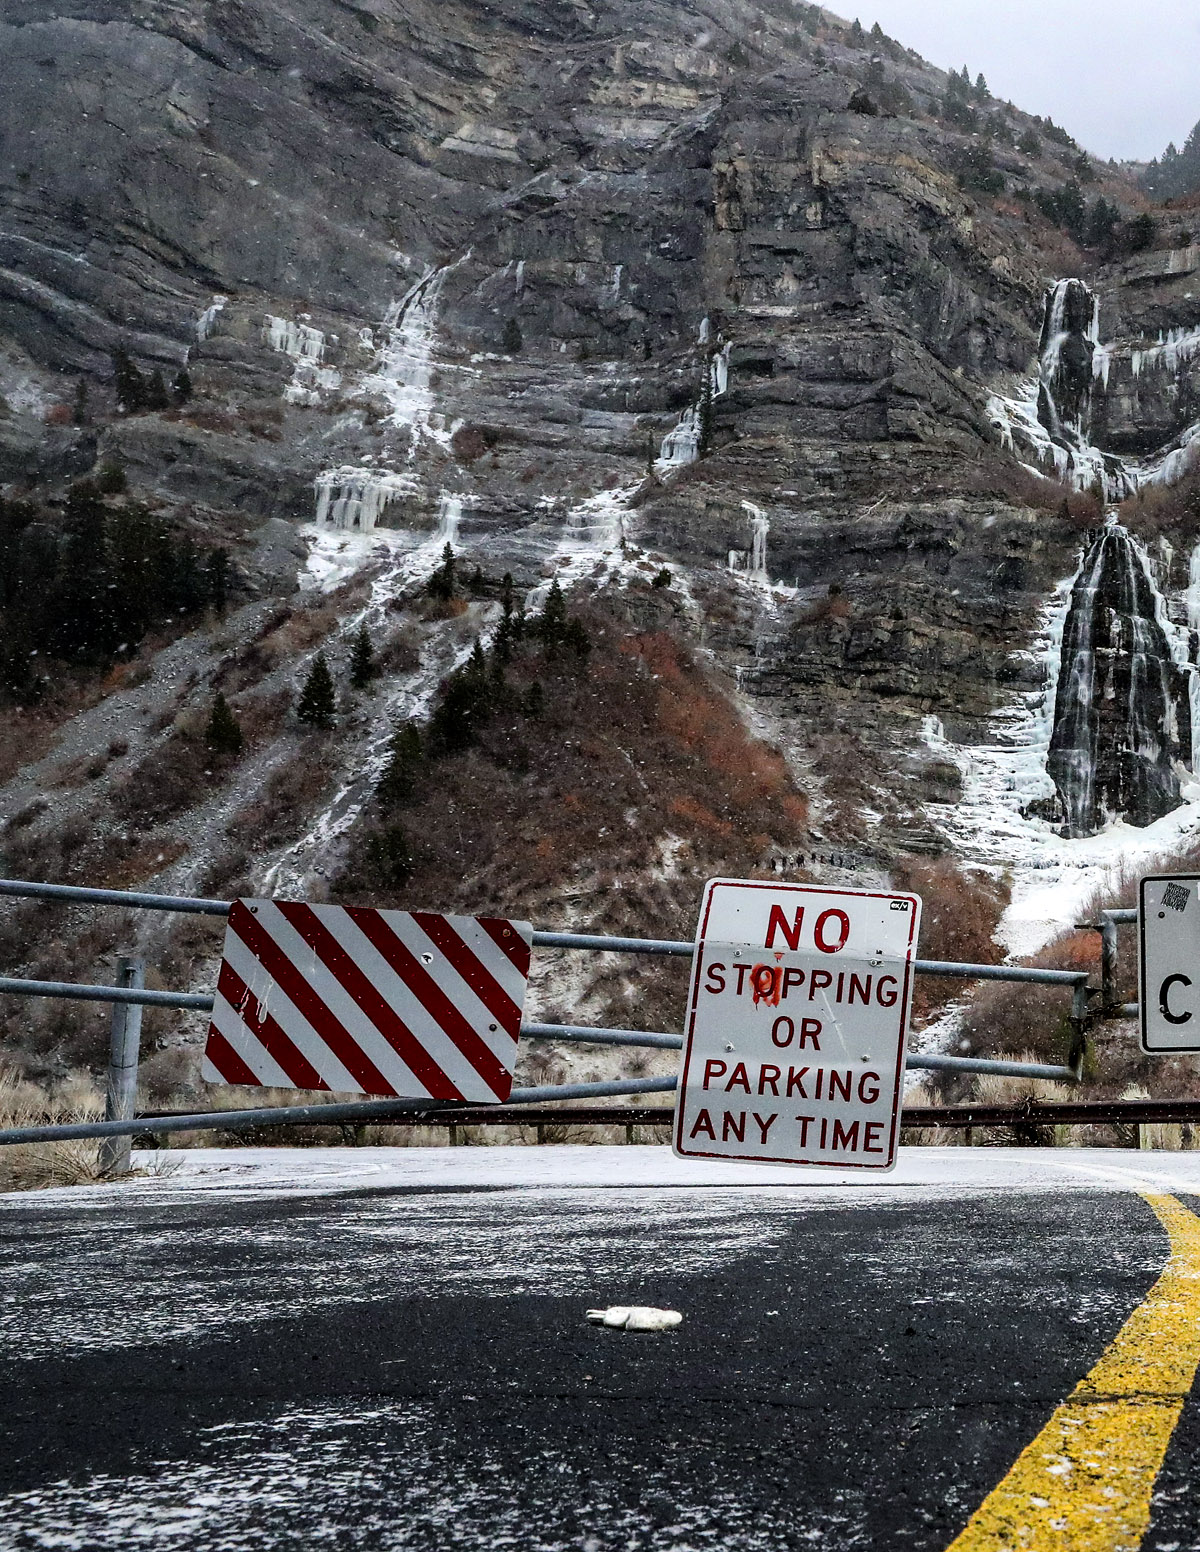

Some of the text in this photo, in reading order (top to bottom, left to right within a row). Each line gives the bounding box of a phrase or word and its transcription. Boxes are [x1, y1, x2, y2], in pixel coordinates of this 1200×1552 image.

[765, 905, 849, 953] NO
[704, 963, 898, 1008] STOPPING
[772, 1016, 822, 1050] OR
[703, 1059, 880, 1104] PARKING
[690, 1109, 885, 1152] ANY TIME
